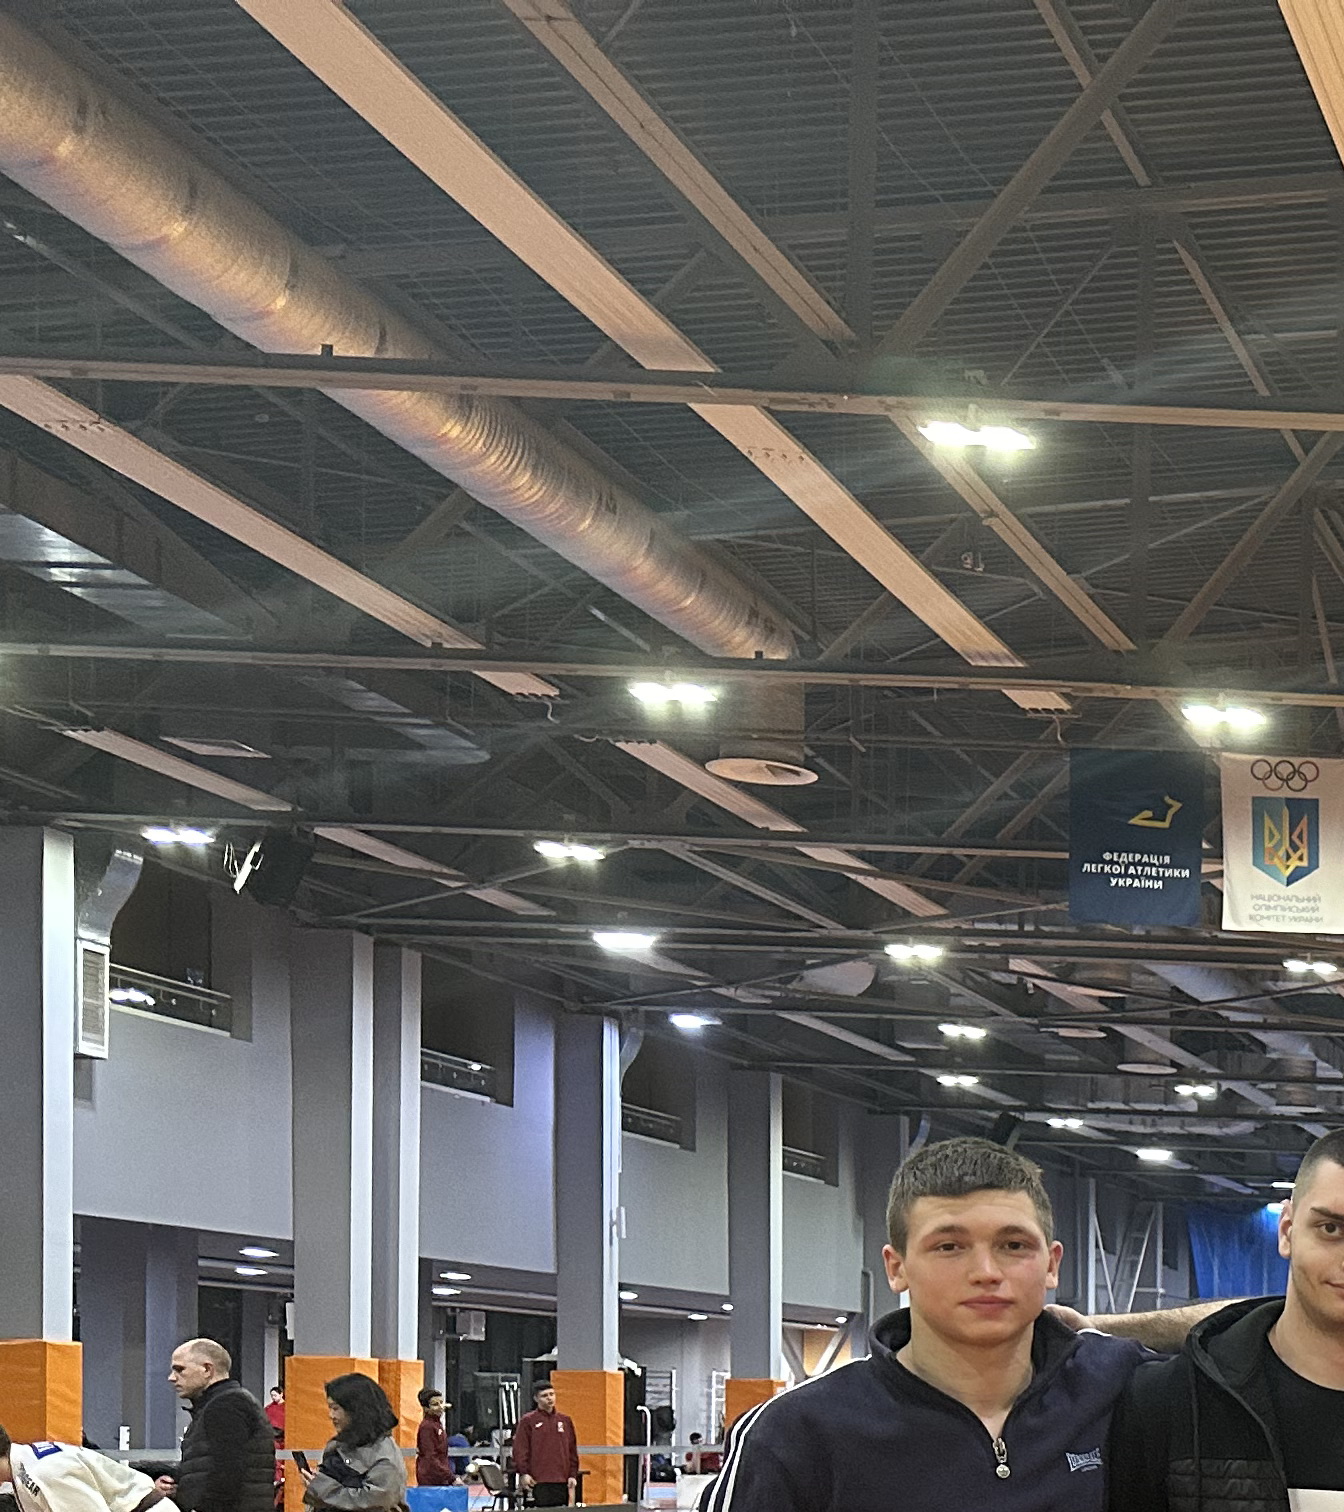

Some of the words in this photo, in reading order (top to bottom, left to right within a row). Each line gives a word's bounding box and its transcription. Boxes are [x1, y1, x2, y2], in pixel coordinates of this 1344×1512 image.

[1102, 851, 1171, 866] ФЕДЕРАЦІЯ
[1082, 862, 1125, 874] ЛЕГКОЇ
[1127, 865, 1190, 879] АТЛЕТИКИ
[1109, 876, 1163, 890] УКРАЇНИ
